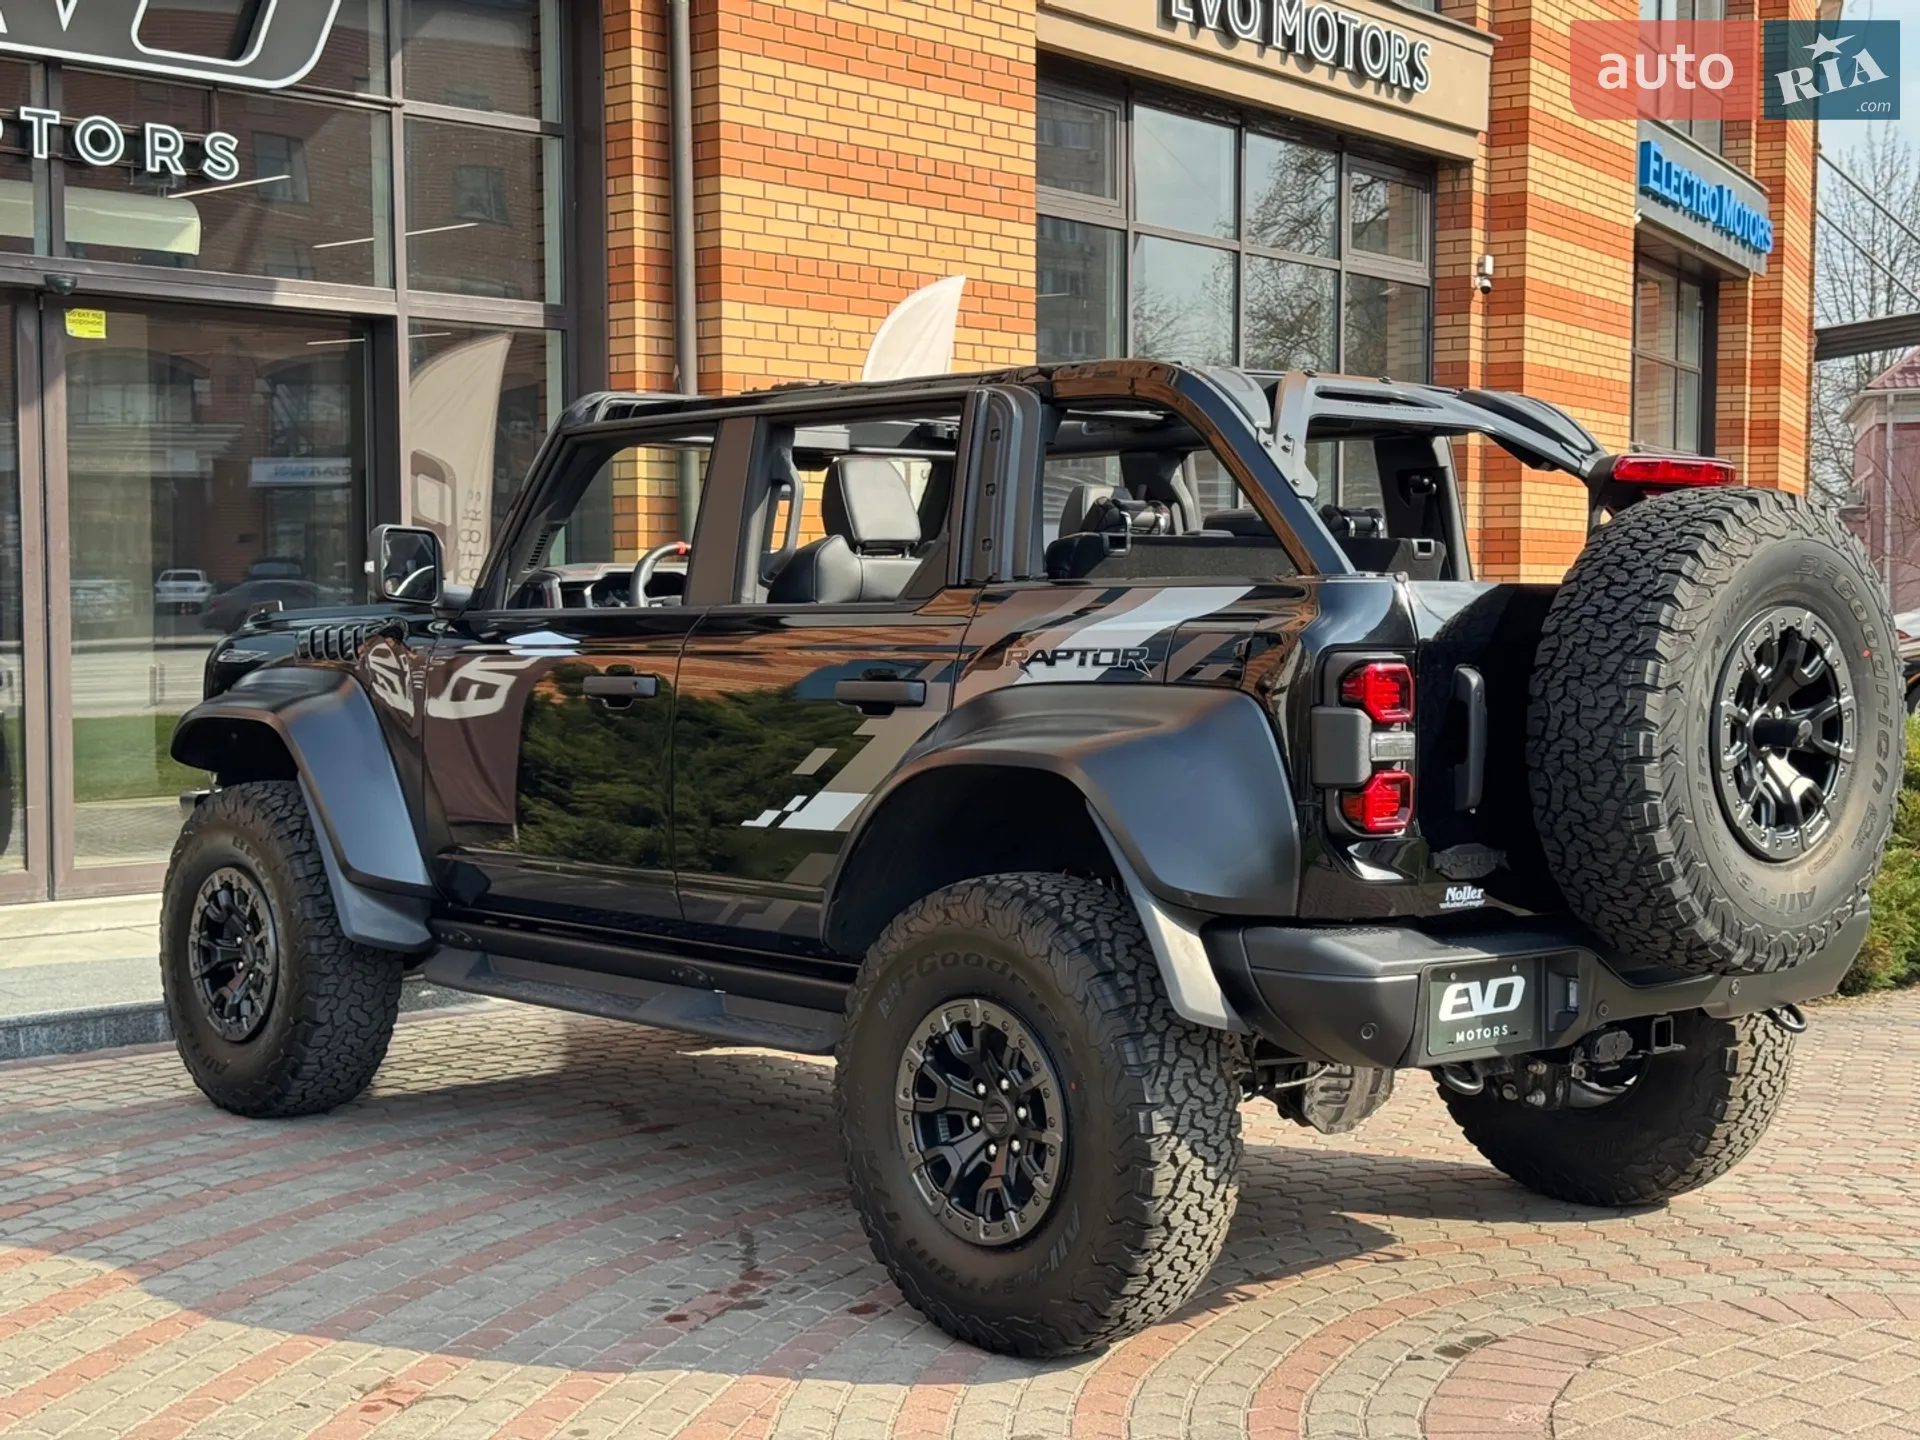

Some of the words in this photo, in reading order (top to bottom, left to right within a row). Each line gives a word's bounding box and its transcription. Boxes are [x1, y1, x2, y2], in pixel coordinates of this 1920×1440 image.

[1272, 0, 1431, 93] MOTORS
[0, 106, 240, 181] TORS
[1003, 646, 1153, 679] RAPTOR
[1445, 886, 1485, 901] Noller
[1439, 975, 1526, 1022] EVO
[1456, 1024, 1508, 1043] MOTORS
